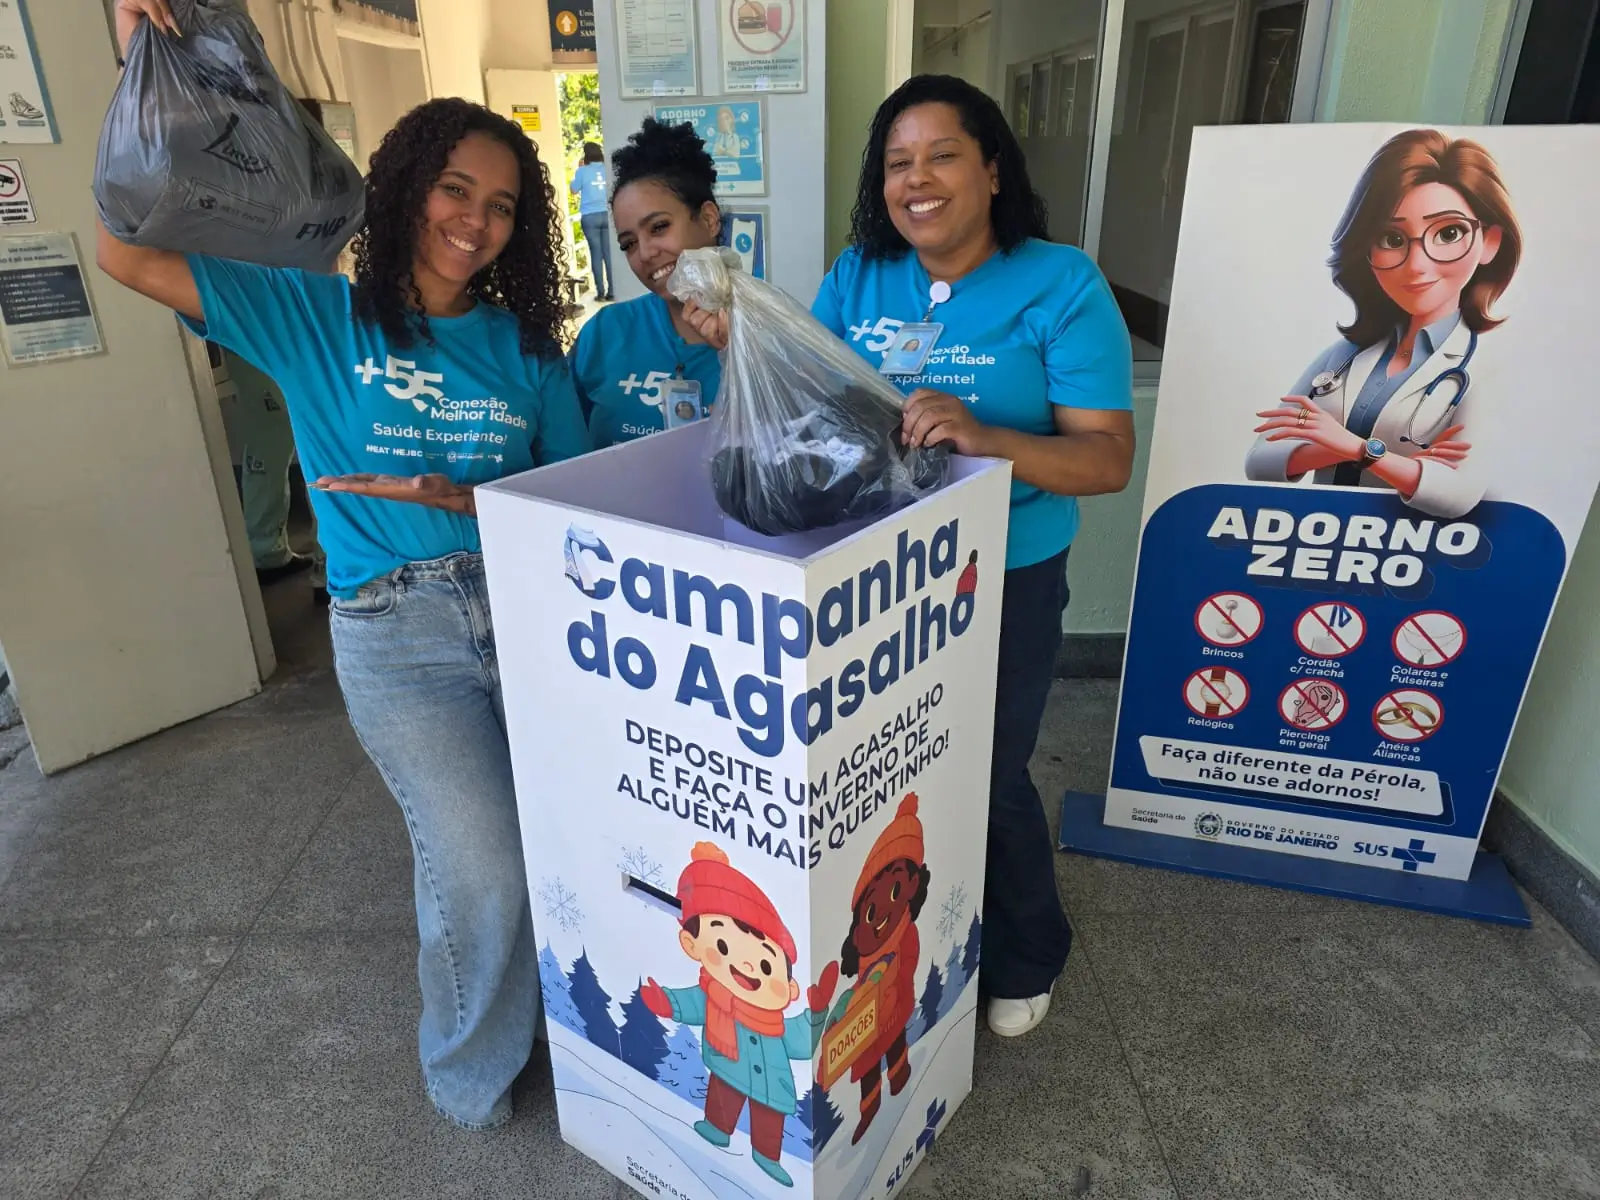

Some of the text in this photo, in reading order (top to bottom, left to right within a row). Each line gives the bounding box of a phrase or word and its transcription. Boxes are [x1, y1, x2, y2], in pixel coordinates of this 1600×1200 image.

[661, 109, 706, 119] ADORNO
[951, 354, 996, 365] Idade
[886, 372, 976, 386] Experiente!
[439, 397, 508, 411] Conexão
[431, 407, 528, 430] Melhor Idade
[372, 422, 508, 446] Saúde Experiente!
[366, 444, 390, 455] HEAT
[1207, 507, 1481, 556] ADORNO
[1246, 546, 1424, 587] ZERO
[568, 518, 960, 678] Campanha
[1202, 647, 1244, 659] Brincos
[1297, 656, 1341, 668] Cordão
[567, 593, 976, 757] do Agasalho
[1290, 665, 1345, 678] c/ crachá
[1391, 665, 1449, 679] Colares e
[1390, 675, 1445, 688] Pulseiras
[1187, 717, 1235, 730] Relógios
[1279, 728, 1331, 743] Piercings
[625, 682, 944, 808] DEPOSITE UM AGASALHO
[1279, 739, 1328, 751] em geral
[1378, 740, 1409, 752] Anéis
[1373, 749, 1422, 763] Alianças
[1160, 742, 1428, 794] Faça diferente da Pérola,
[650, 719, 930, 840] E FAÇA O INVERNO DE
[1198, 763, 1382, 803] não use adornos!
[617, 728, 950, 870] ALGUÉM MAIS QUENTINHO!
[1131, 815, 1159, 825] Saúde
[1132, 807, 1187, 821] Secretaria de
[1226, 819, 1341, 842] GOVERNO DO ESTADO
[1226, 825, 1251, 838] RIO
[1254, 830, 1273, 842] DE
[1275, 833, 1339, 850] JANEIRO
[1353, 841, 1390, 857] SUS
[829, 1007, 875, 1064] DOAÇÕES
[626, 1155, 678, 1197] Secretaria
[886, 1146, 914, 1196] SUS
[627, 1166, 661, 1195] Saúde
